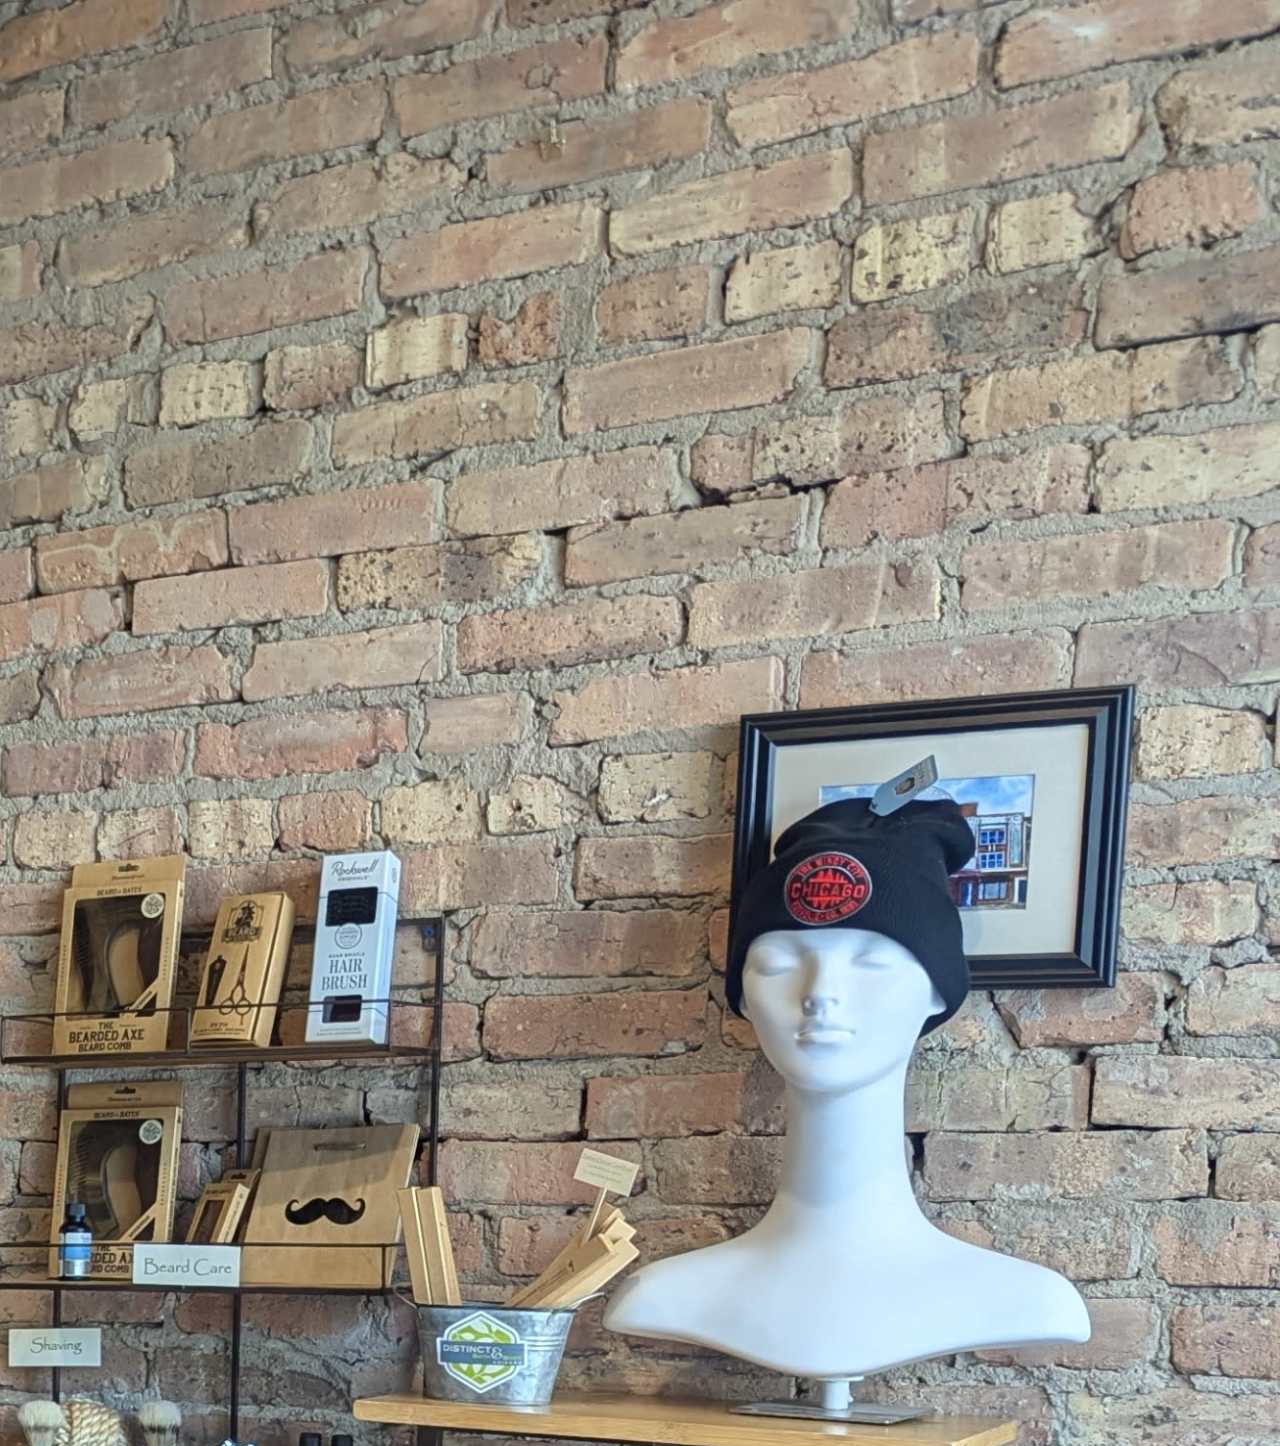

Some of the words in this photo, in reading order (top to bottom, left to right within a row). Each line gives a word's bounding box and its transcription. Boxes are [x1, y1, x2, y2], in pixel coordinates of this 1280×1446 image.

[331, 858, 380, 878] Rockwell
[790, 882, 866, 899] CHICAGO
[329, 958, 364, 975] HAIR
[321, 974, 369, 992] BRUSH
[68, 1030, 119, 1044] BEARDED
[121, 1028, 145, 1041] AXE
[77, 1042, 105, 1052] BEARD
[106, 1040, 132, 1050] COMB
[144, 1257, 190, 1276] Beard
[193, 1258, 233, 1277] Care
[29, 1336, 83, 1356] Shaving
[442, 1344, 491, 1354] DISTINCT
